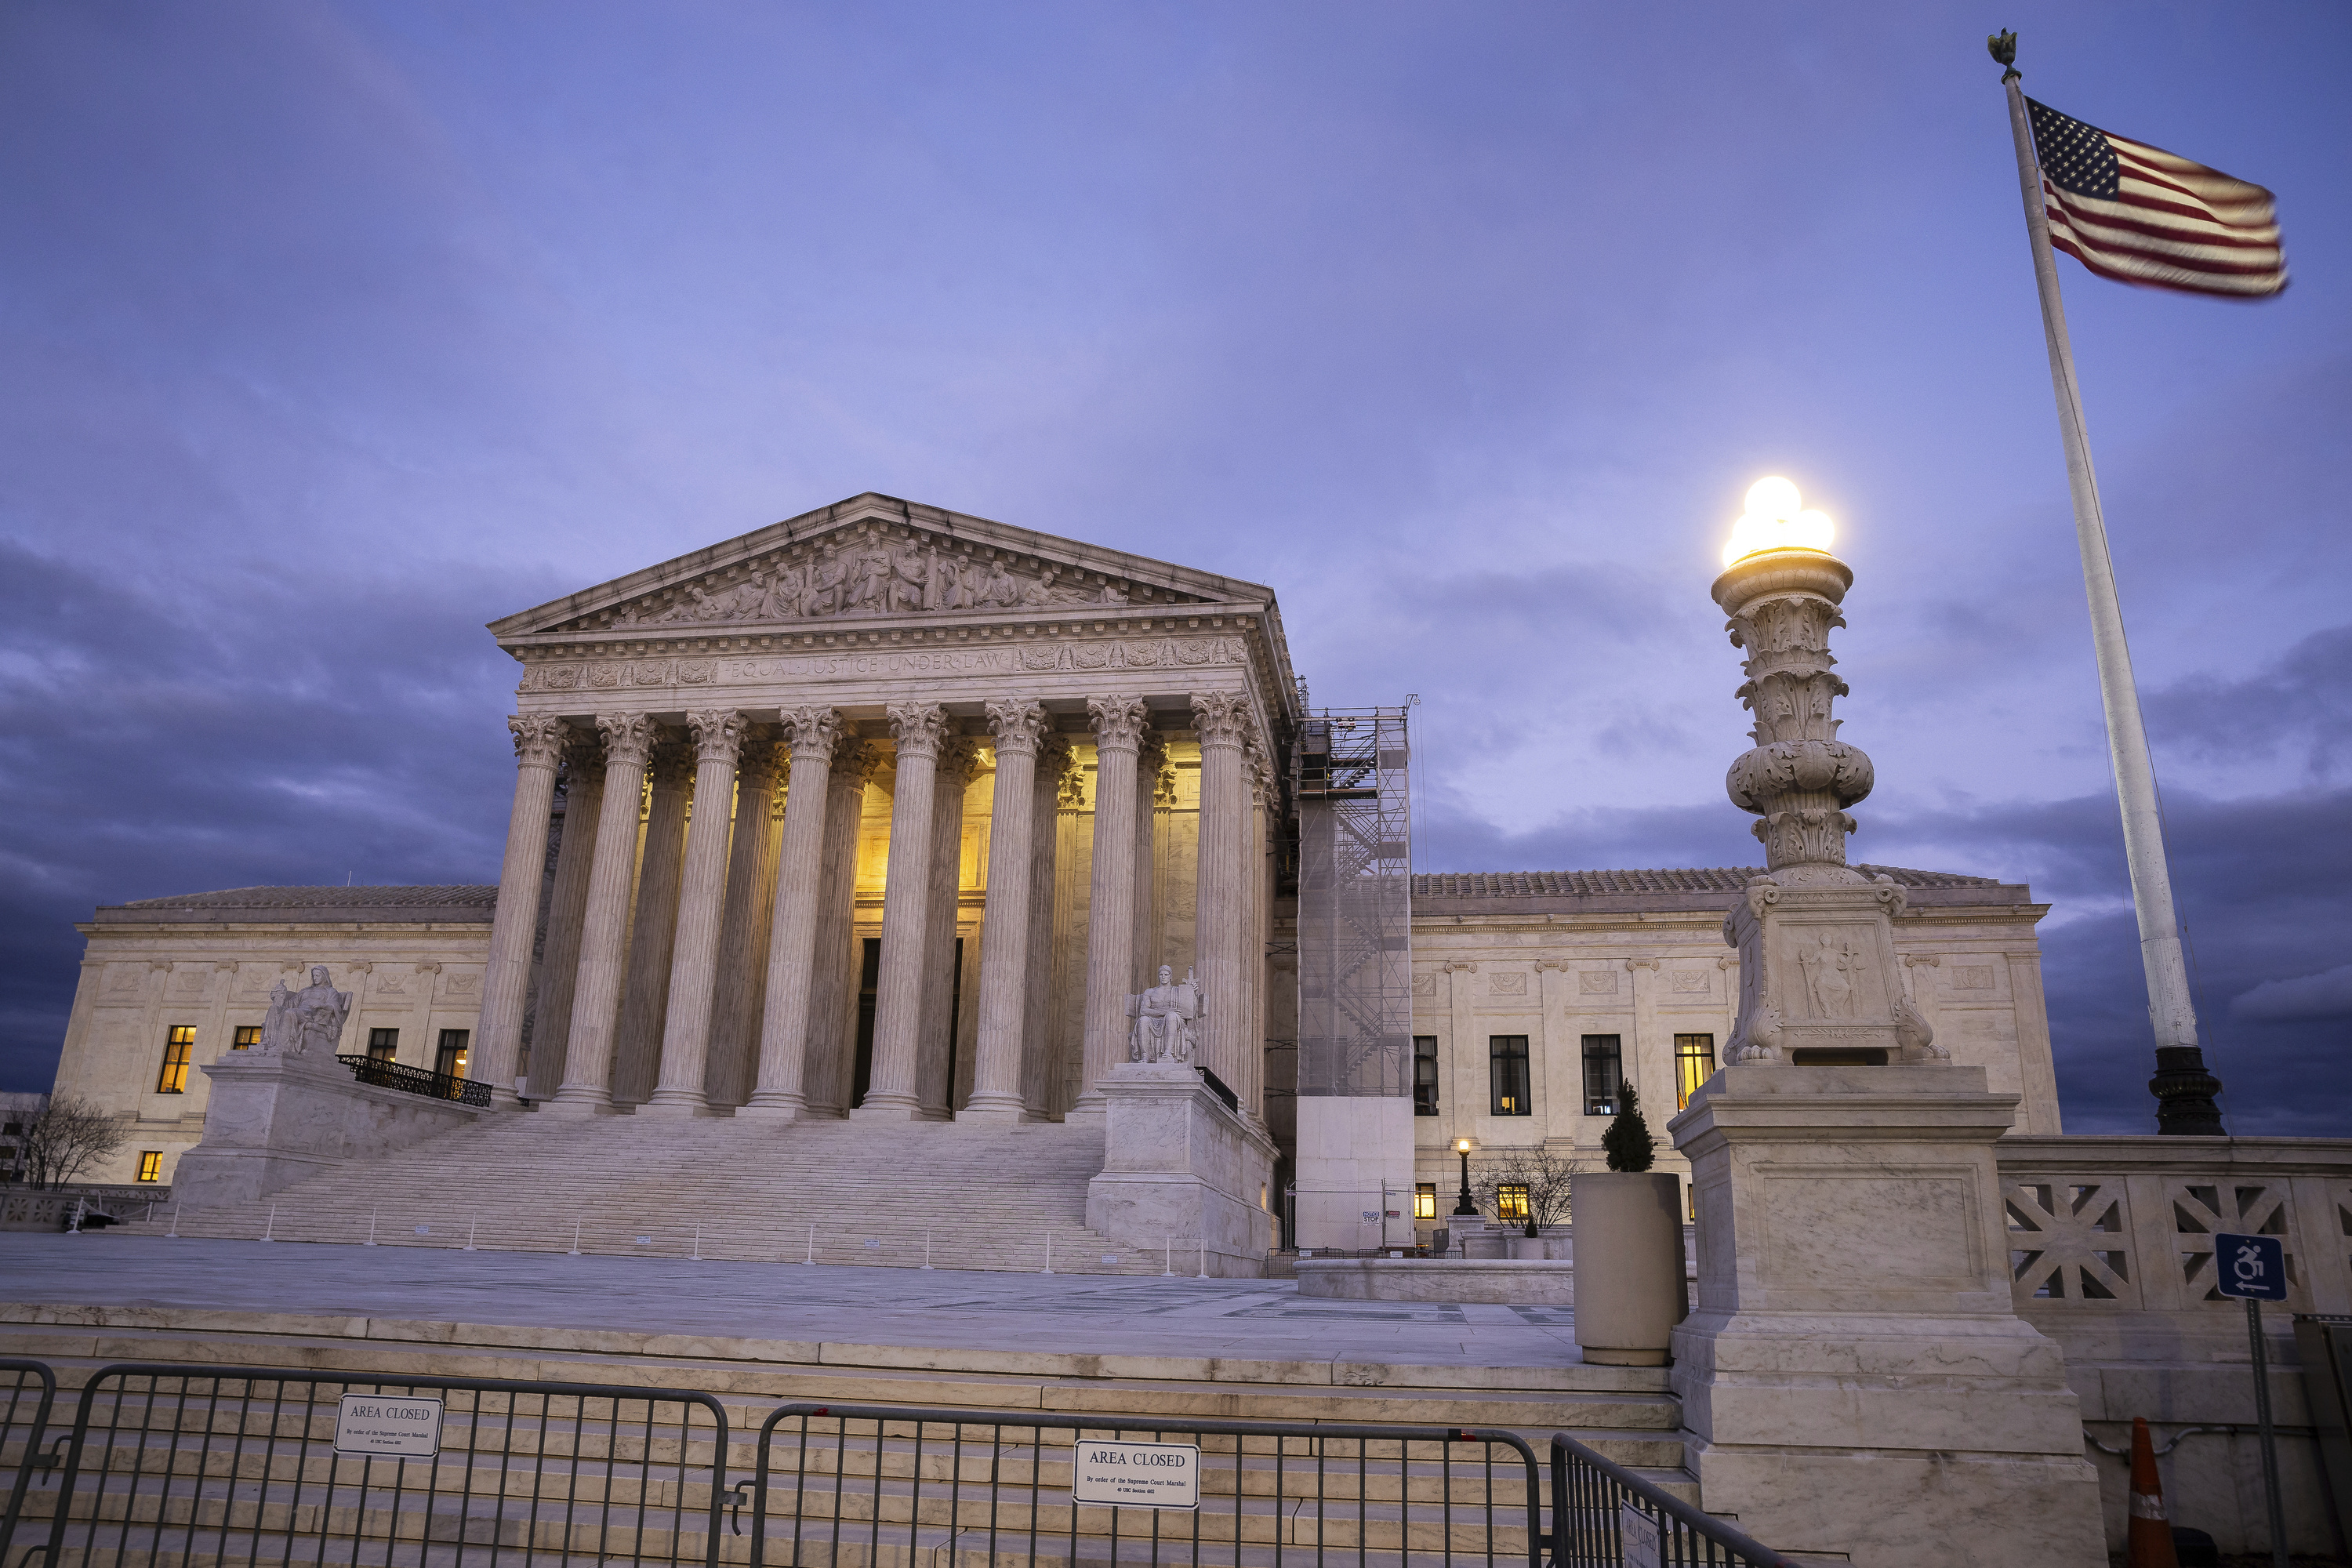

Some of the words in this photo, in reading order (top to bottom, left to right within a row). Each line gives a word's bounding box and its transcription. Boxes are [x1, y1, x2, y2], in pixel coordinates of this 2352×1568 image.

[731, 662, 796, 677] EQUAL
[800, 658, 878, 674] JUSTICE
[889, 654, 955, 670] UNDER
[964, 652, 1003, 668] LAW
[350, 1406, 381, 1417] AREA
[387, 1407, 430, 1420] CLOSED
[1090, 1451, 1127, 1465] AREA
[1133, 1454, 1185, 1468] CLOSED
